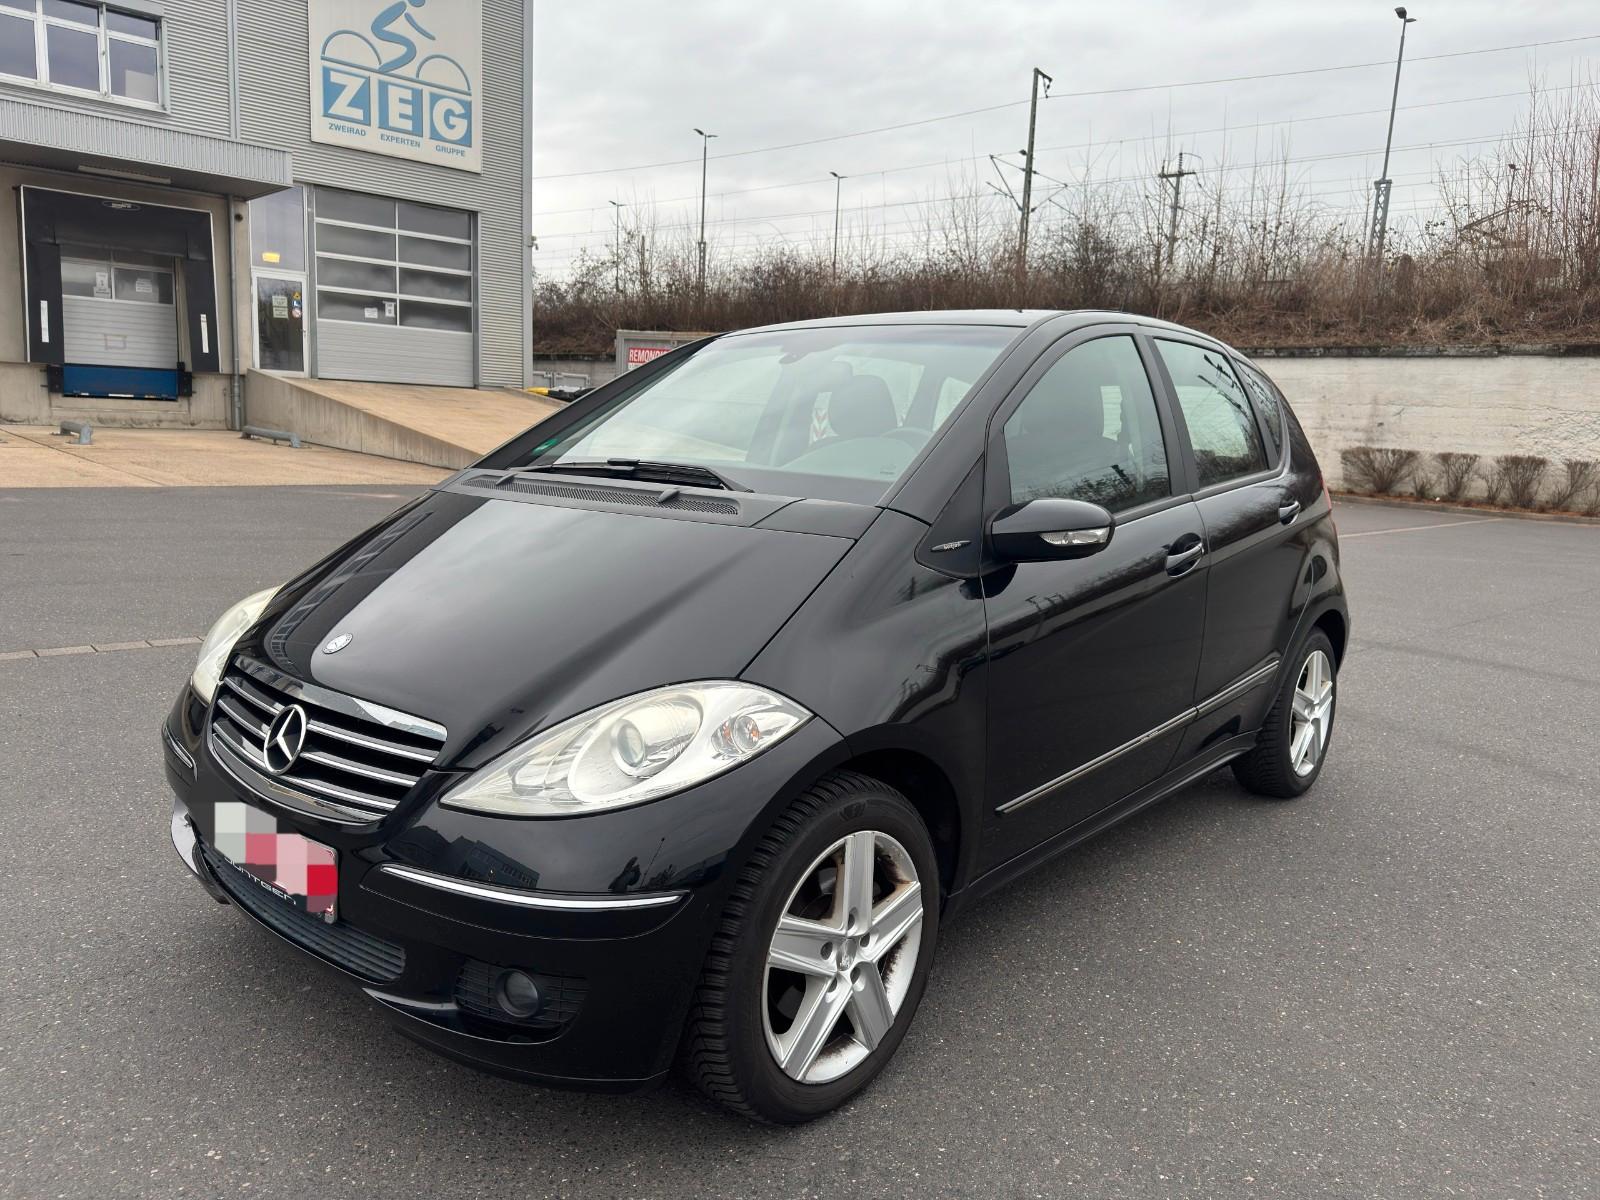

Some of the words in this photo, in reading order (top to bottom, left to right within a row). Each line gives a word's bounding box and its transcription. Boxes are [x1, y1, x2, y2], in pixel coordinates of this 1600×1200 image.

[327, 70, 468, 141] ZEG
[328, 122, 367, 137] ZWEIRAD
[380, 133, 421, 148] EXPERTEN
[435, 144, 466, 157] GRUPPE
[629, 349, 669, 361] REMOND
